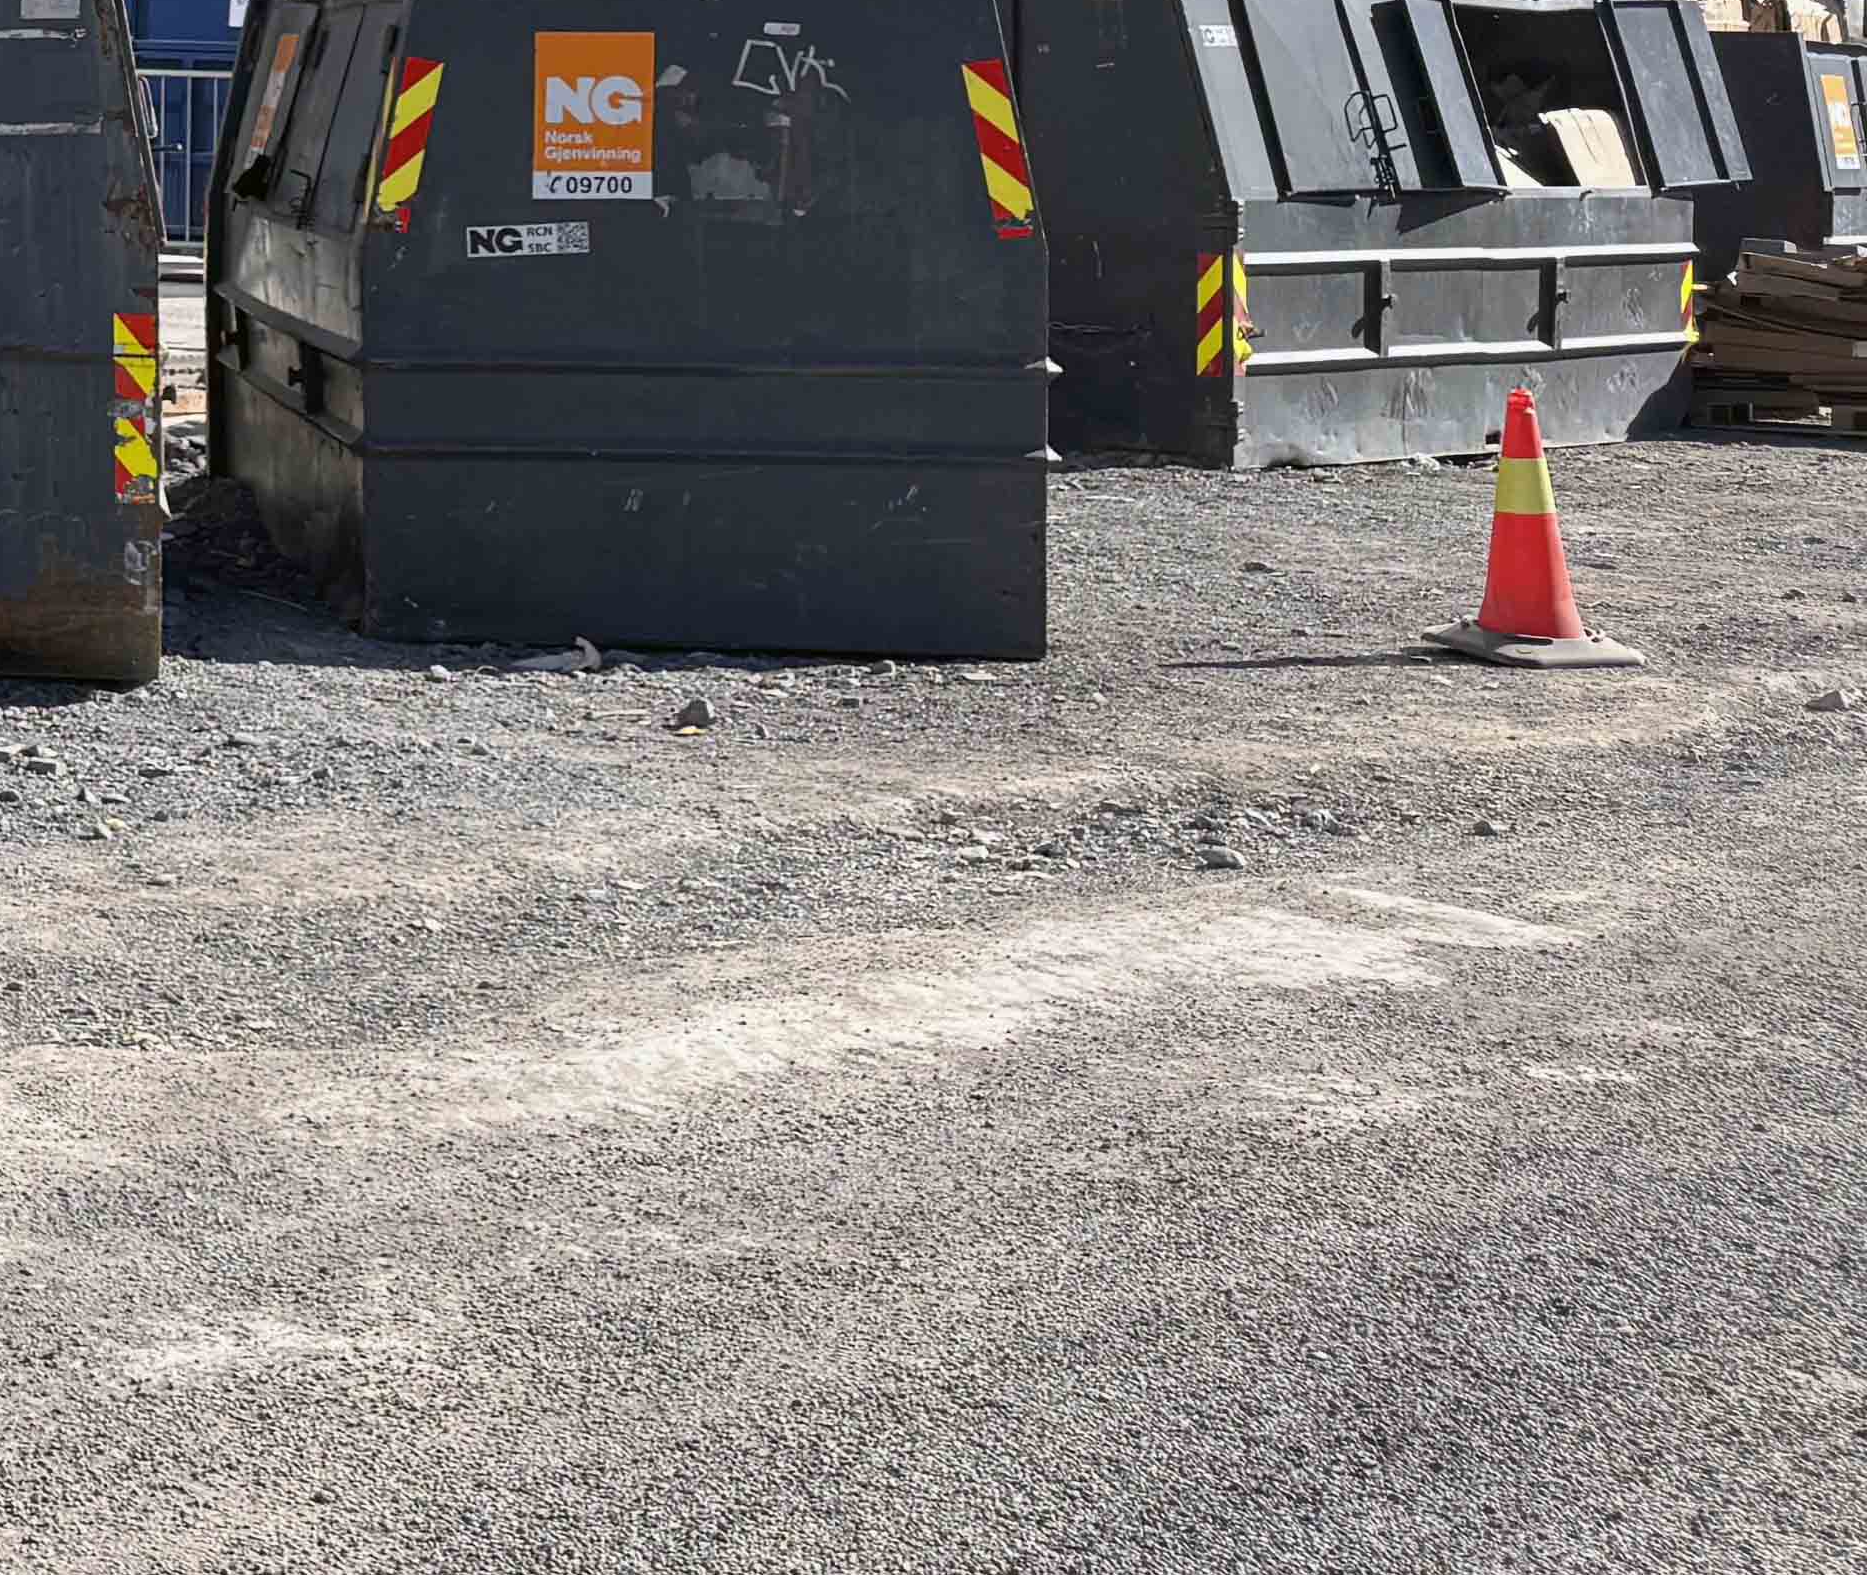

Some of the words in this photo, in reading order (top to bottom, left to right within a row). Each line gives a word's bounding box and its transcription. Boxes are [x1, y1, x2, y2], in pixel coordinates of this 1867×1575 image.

[545, 75, 643, 125] NG
[545, 130, 594, 144] Norsk
[545, 146, 642, 163] Gjenvinning
[566, 176, 633, 194] 09700
[469, 227, 524, 254] NG
